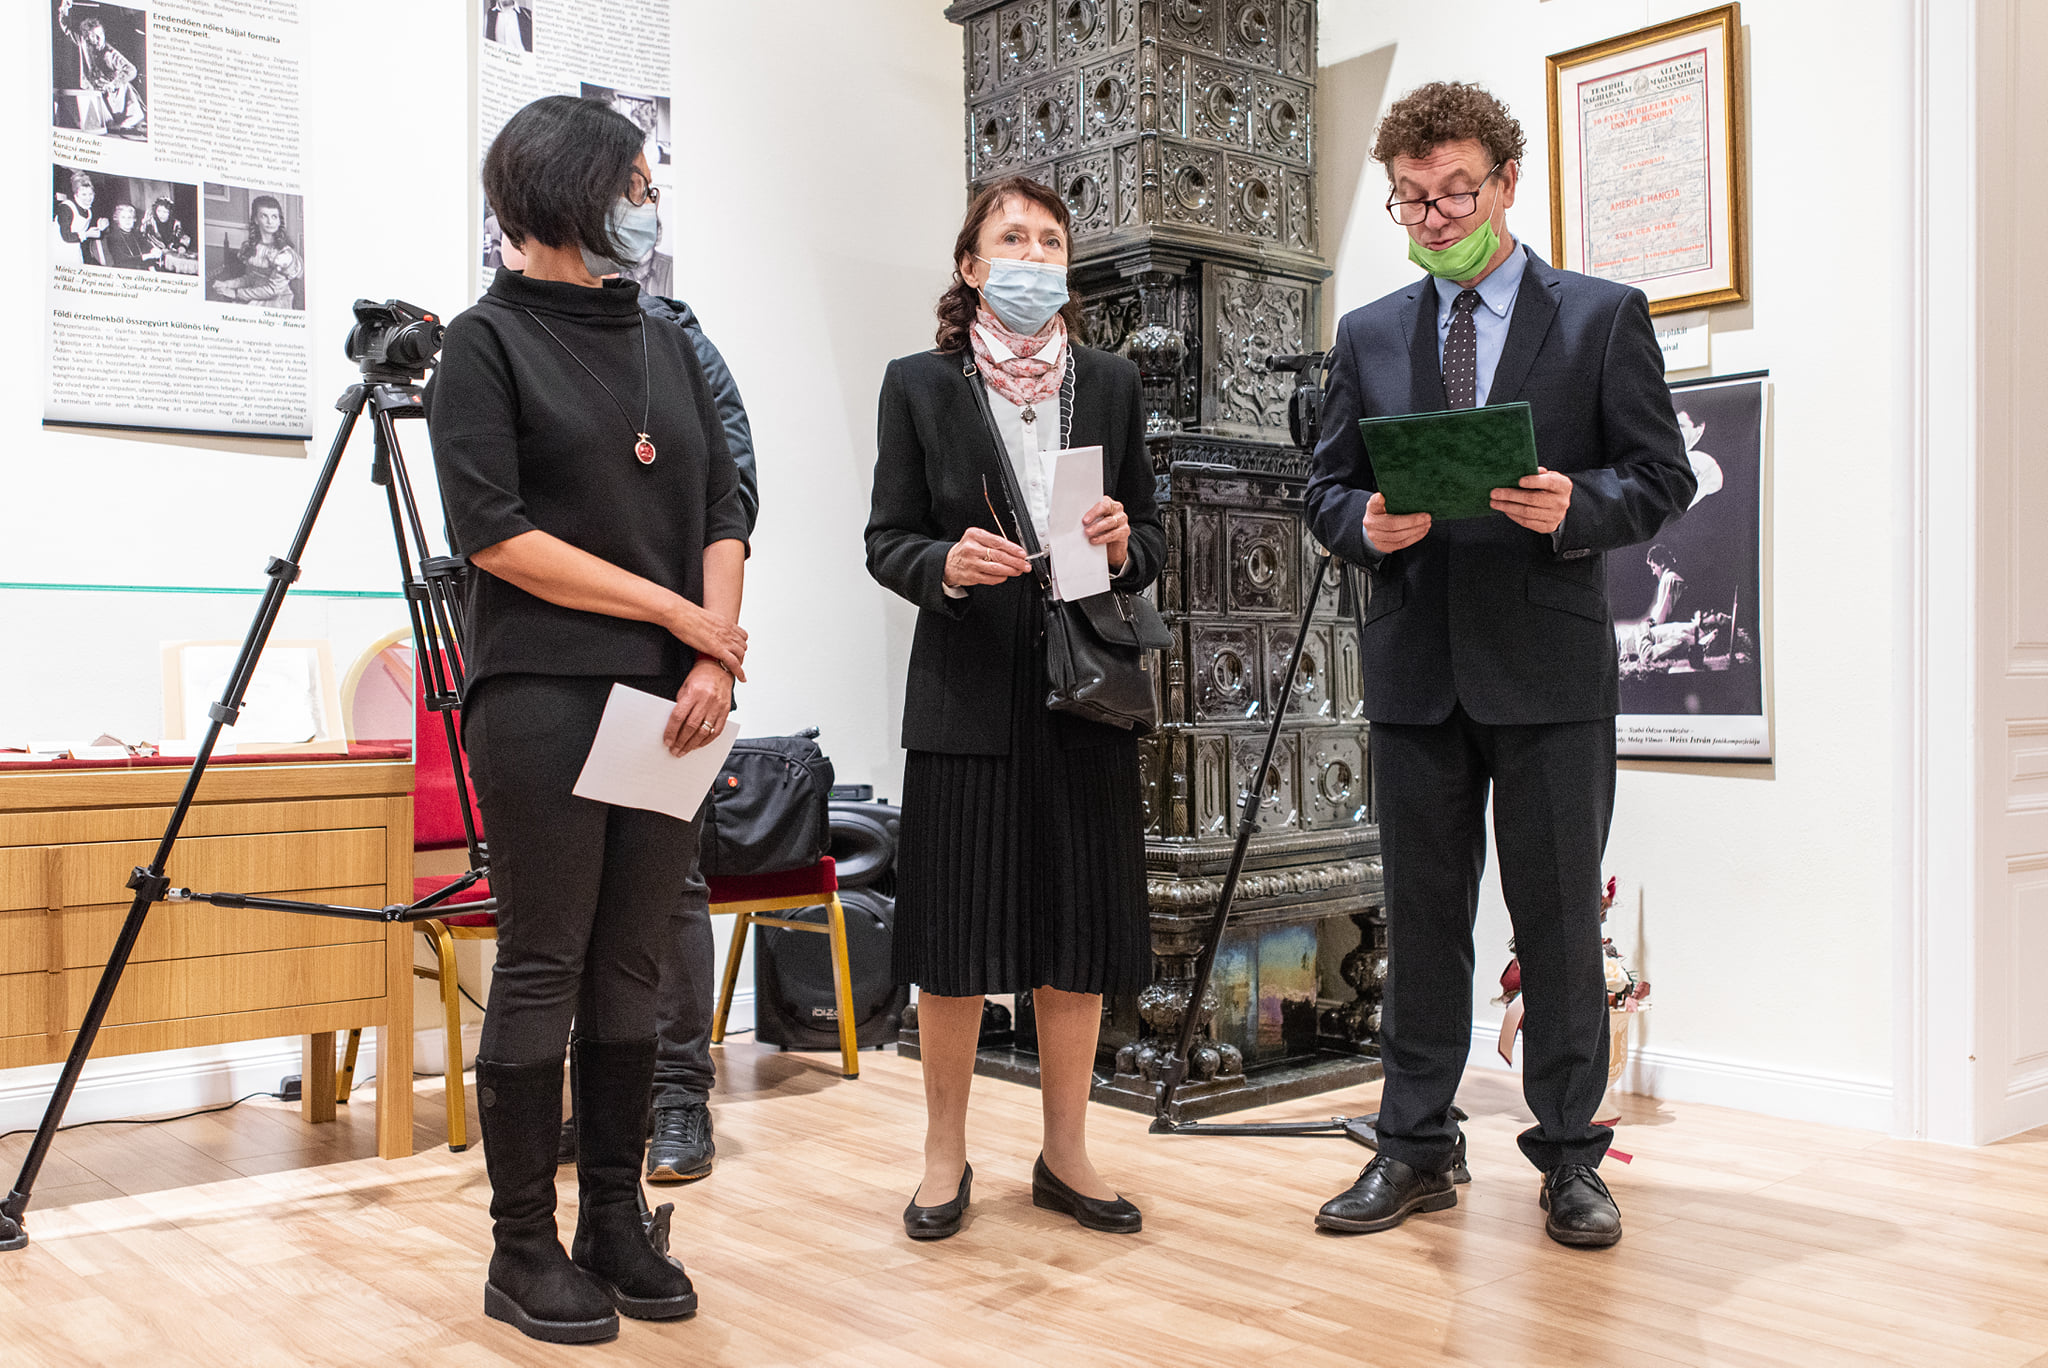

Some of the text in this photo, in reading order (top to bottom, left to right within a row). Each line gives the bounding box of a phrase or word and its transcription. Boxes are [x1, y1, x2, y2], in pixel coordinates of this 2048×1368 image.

[153, 13, 280, 44] Eredendően nőies bájjal formálta
[153, 24, 210, 39] meg szerepeit.
[53, 131, 102, 147] Bertolt Brecht:
[53, 141, 77, 152] Kurázsi
[79, 147, 100, 156] mama
[54, 150, 98, 164] Néma Kattrin
[1610, 188, 1680, 211] AMERIKA HANGJA
[55, 265, 76, 275] Móricz
[78, 269, 113, 280] Zsigmond:
[117, 273, 132, 281] Nem
[134, 275, 158, 284] élhetek
[54, 274, 74, 283] nélkül
[122, 283, 152, 292] Szokolay
[89, 288, 138, 299] Annamáriával
[53, 310, 219, 333] Földi érzelmekből összegyúrt különös lény
[264, 311, 305, 320] Shakespeare:
